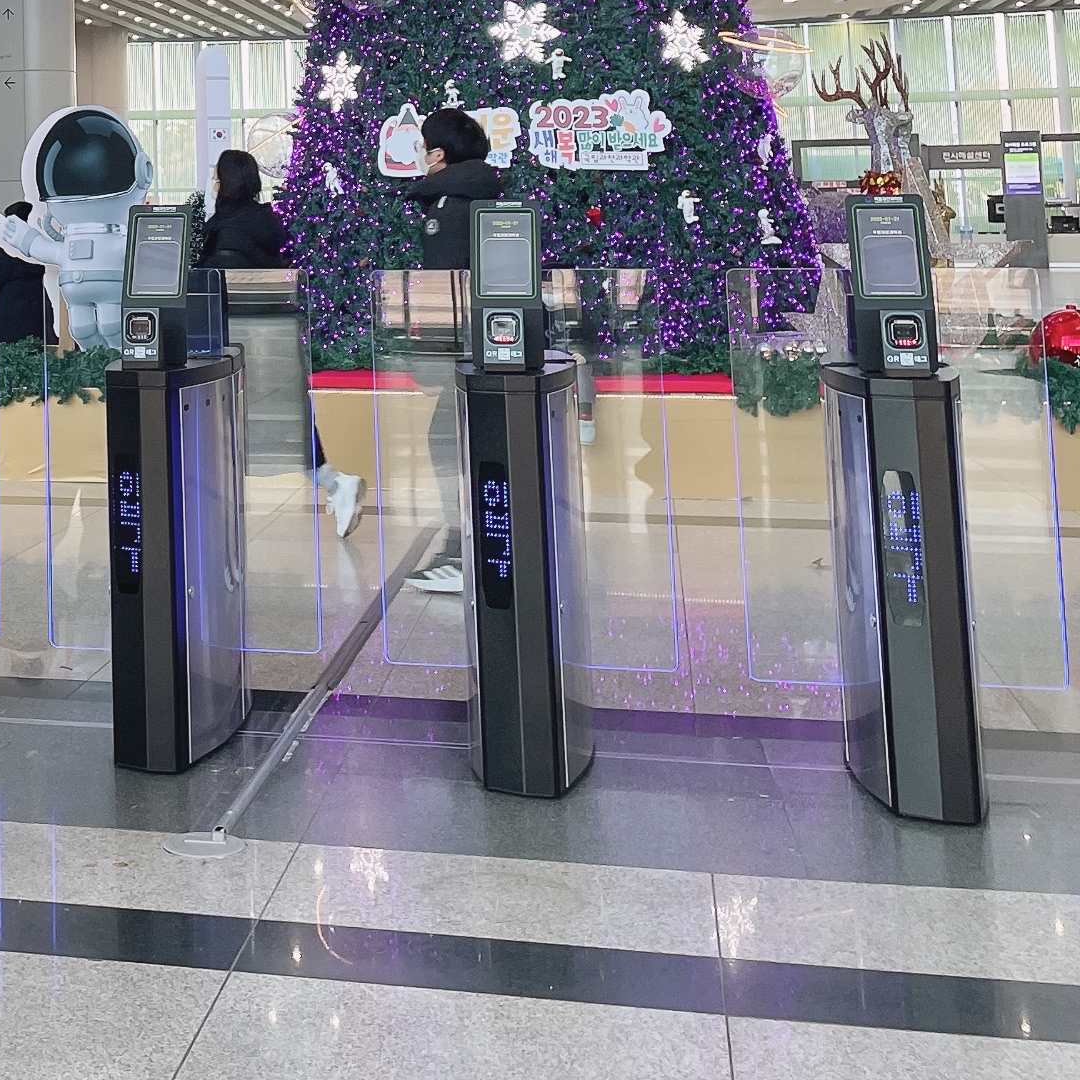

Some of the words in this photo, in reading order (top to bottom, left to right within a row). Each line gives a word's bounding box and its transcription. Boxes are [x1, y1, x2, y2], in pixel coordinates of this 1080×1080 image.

[534, 105, 610, 129] 2023
[557, 130, 576, 165] 복
[579, 132, 606, 152] 많이
[607, 131, 659, 152] 받으세요
[584, 154, 640, 164] 국립과천과학관
[123, 348, 135, 357] QR
[485, 350, 498, 358] QR
[886, 354, 900, 363] QR
